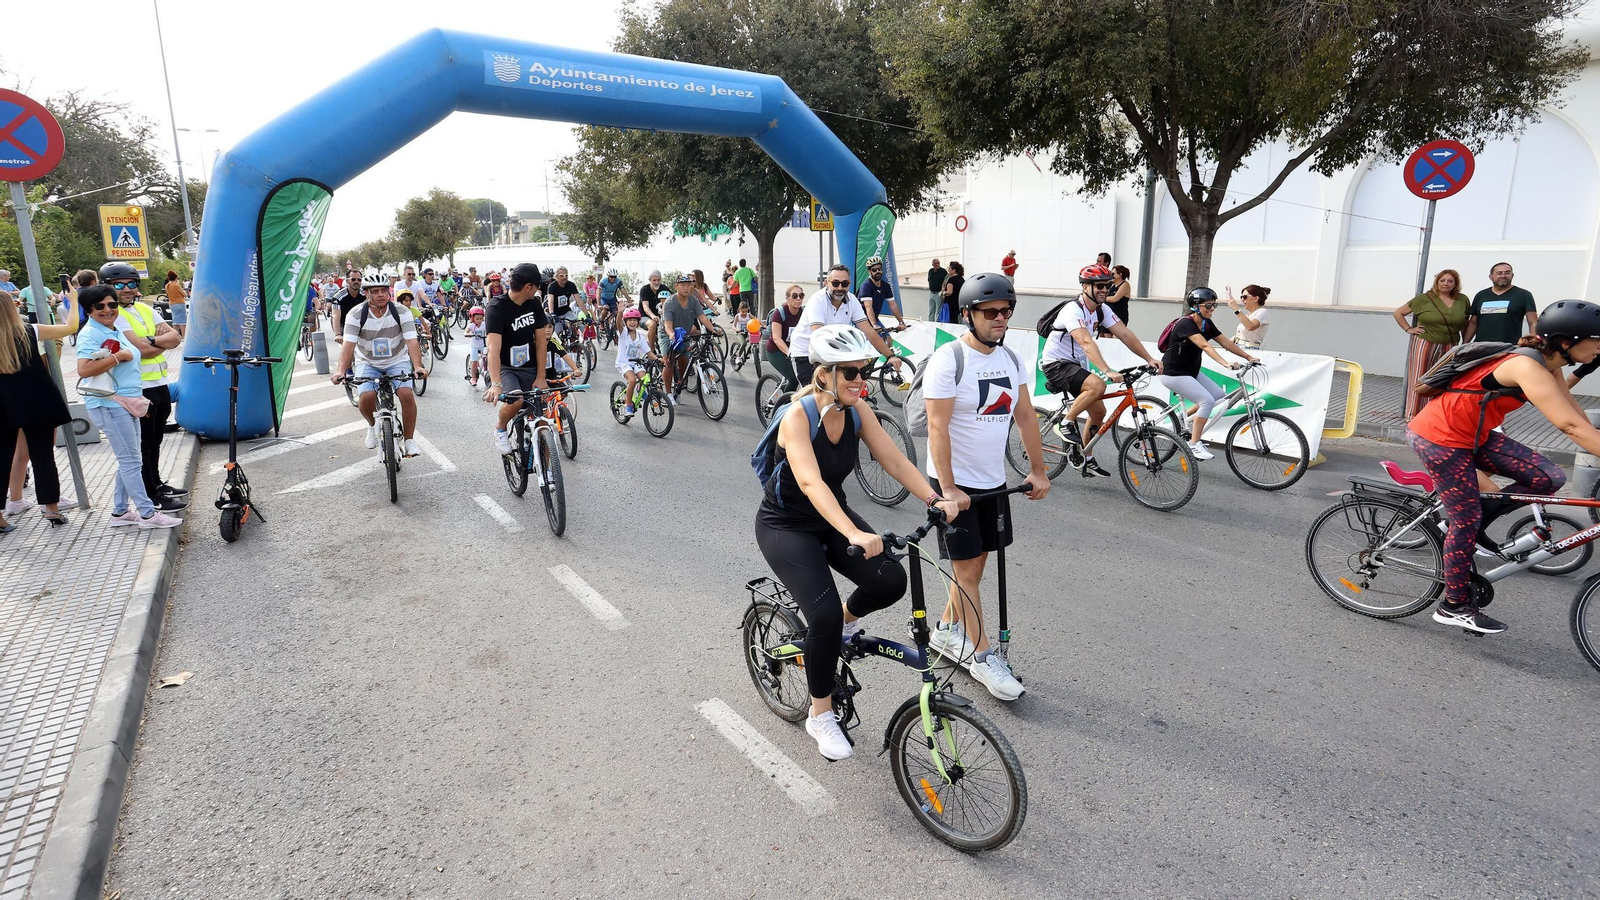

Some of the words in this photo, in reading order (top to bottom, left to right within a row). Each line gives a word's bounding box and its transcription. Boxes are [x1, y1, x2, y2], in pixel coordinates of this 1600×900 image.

[528, 75, 603, 93] Deportes
[529, 62, 679, 91] Ayuntamiento
[684, 80, 706, 93] de
[710, 84, 755, 98] Jerez
[111, 249, 145, 257] PEATONES
[279, 259, 305, 302] Corte
[511, 312, 536, 331] VANS
[976, 370, 1008, 378] TOMMY
[925, 647, 934, 675] bfold
